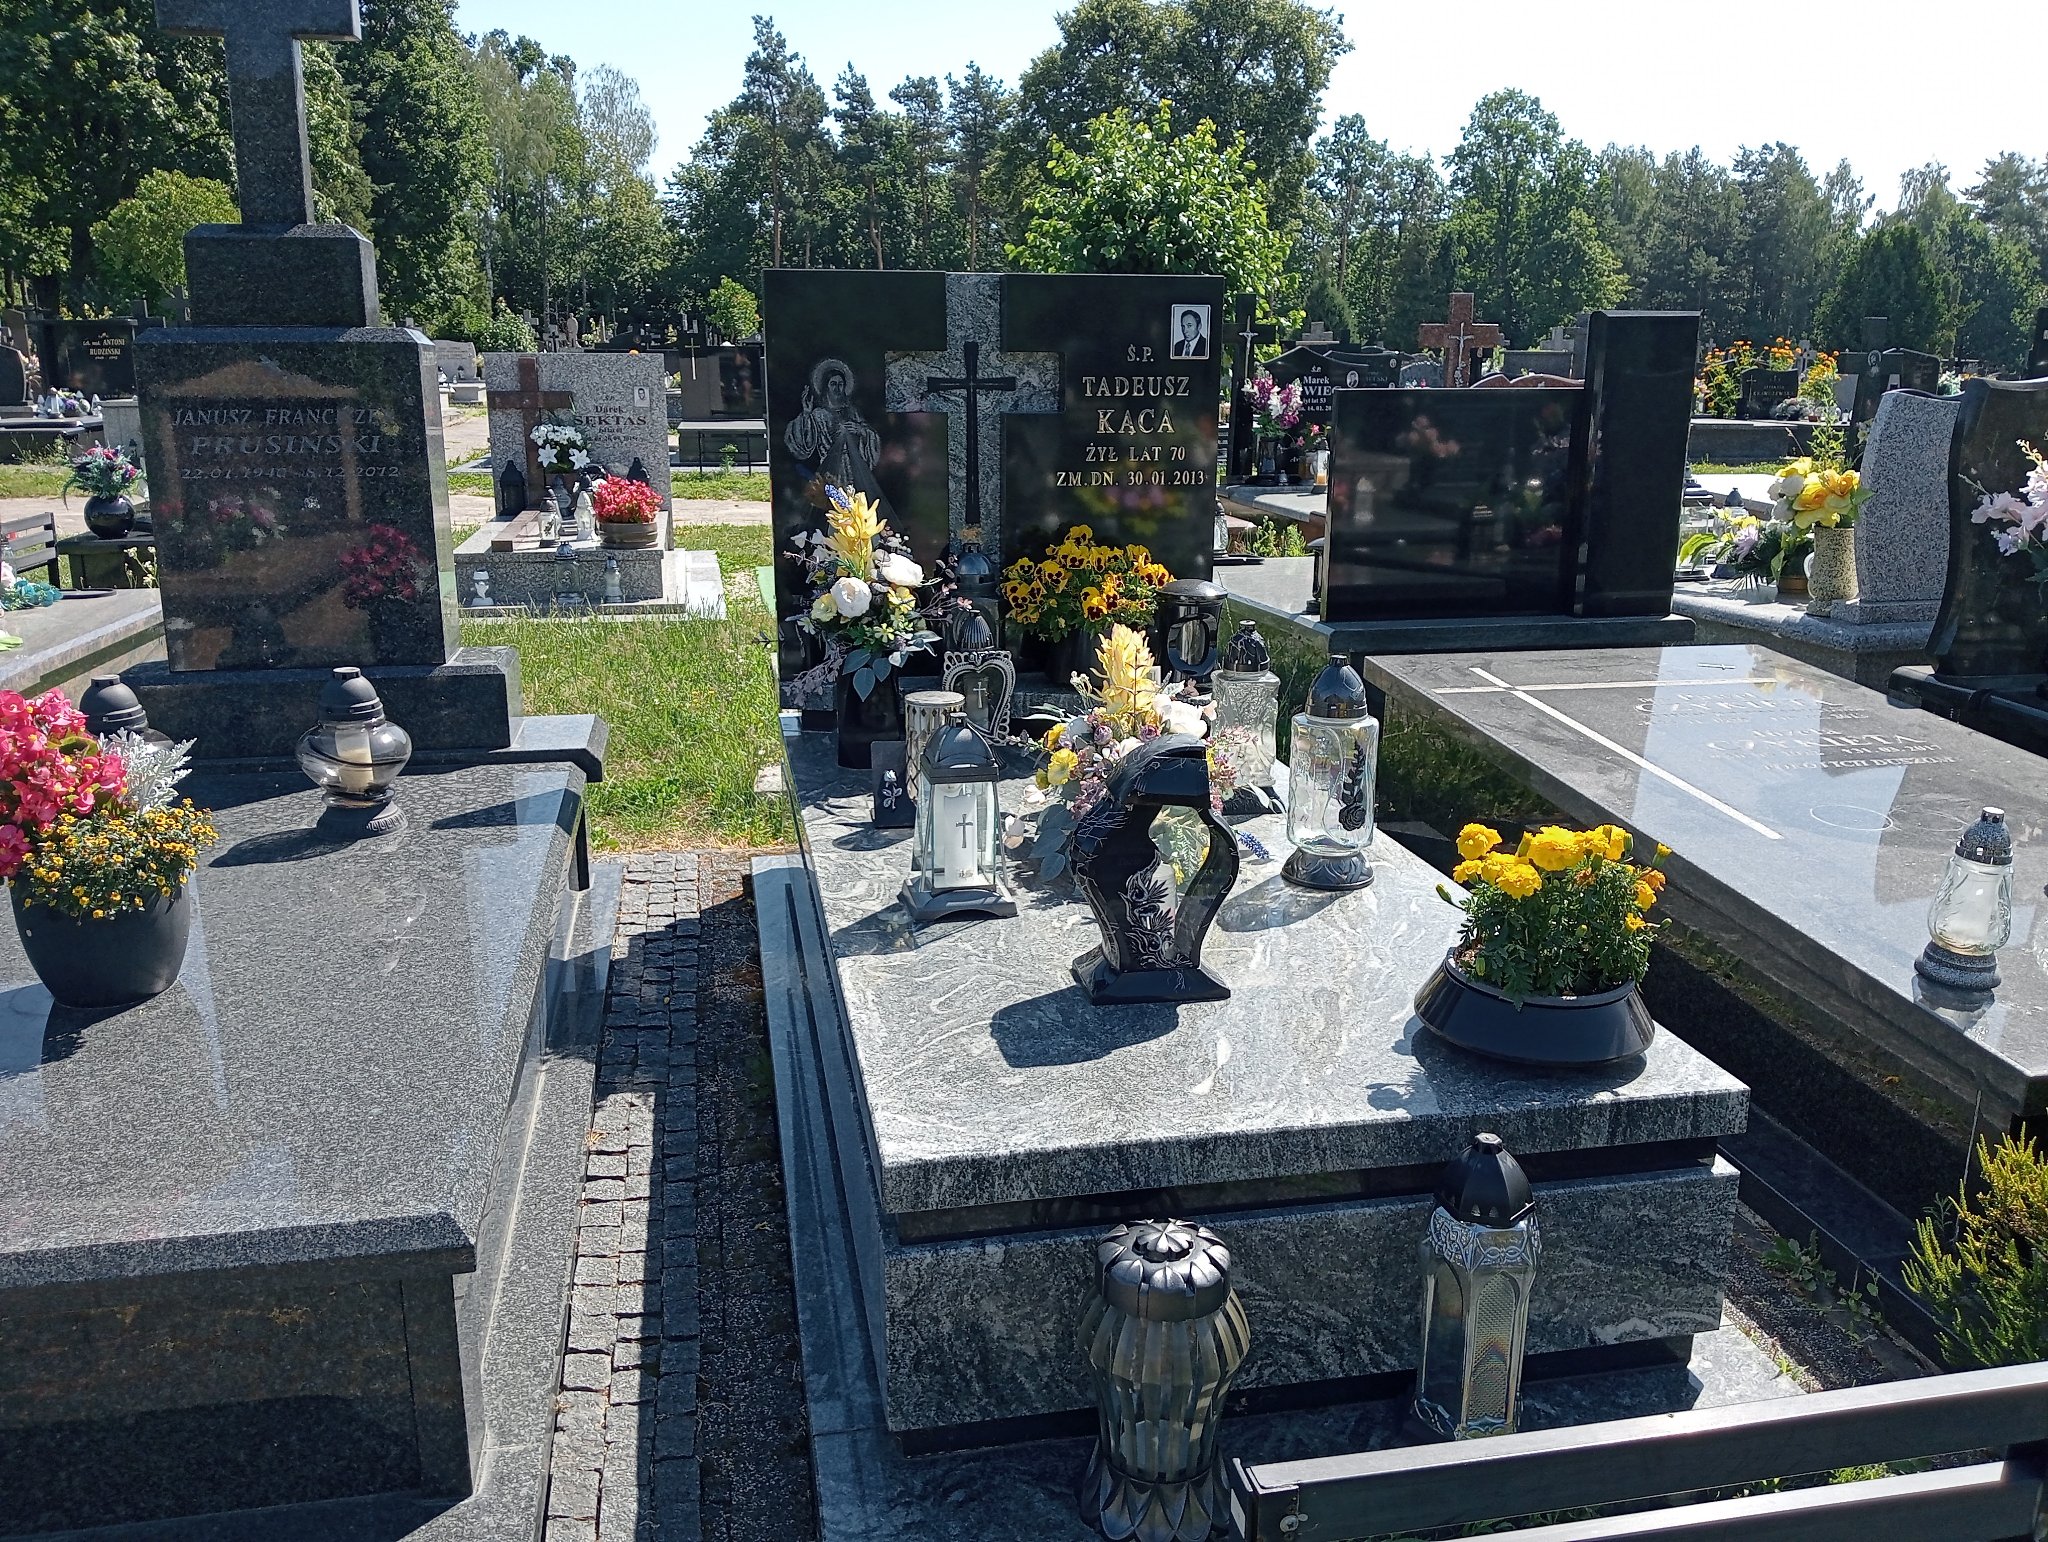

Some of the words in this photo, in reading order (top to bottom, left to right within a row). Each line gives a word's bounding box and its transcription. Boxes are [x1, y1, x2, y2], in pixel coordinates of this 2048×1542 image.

[103, 338, 125, 346] ANTONI
[89, 347, 121, 356] RUDZIŃSKI
[1127, 343, 1155, 362] Ś.P.
[1082, 375, 1190, 397] TADEUSZ
[1303, 375, 1330, 385] Marek
[172, 407, 253, 427] JANUSZ
[595, 405, 625, 414] Darek
[1096, 408, 1176, 436] KĄCA
[1085, 442, 1119, 462] ŻYŁ
[1128, 446, 1162, 463] LAT
[1170, 446, 1186, 461] 70
[1127, 470, 1205, 486] 30.01.2013
